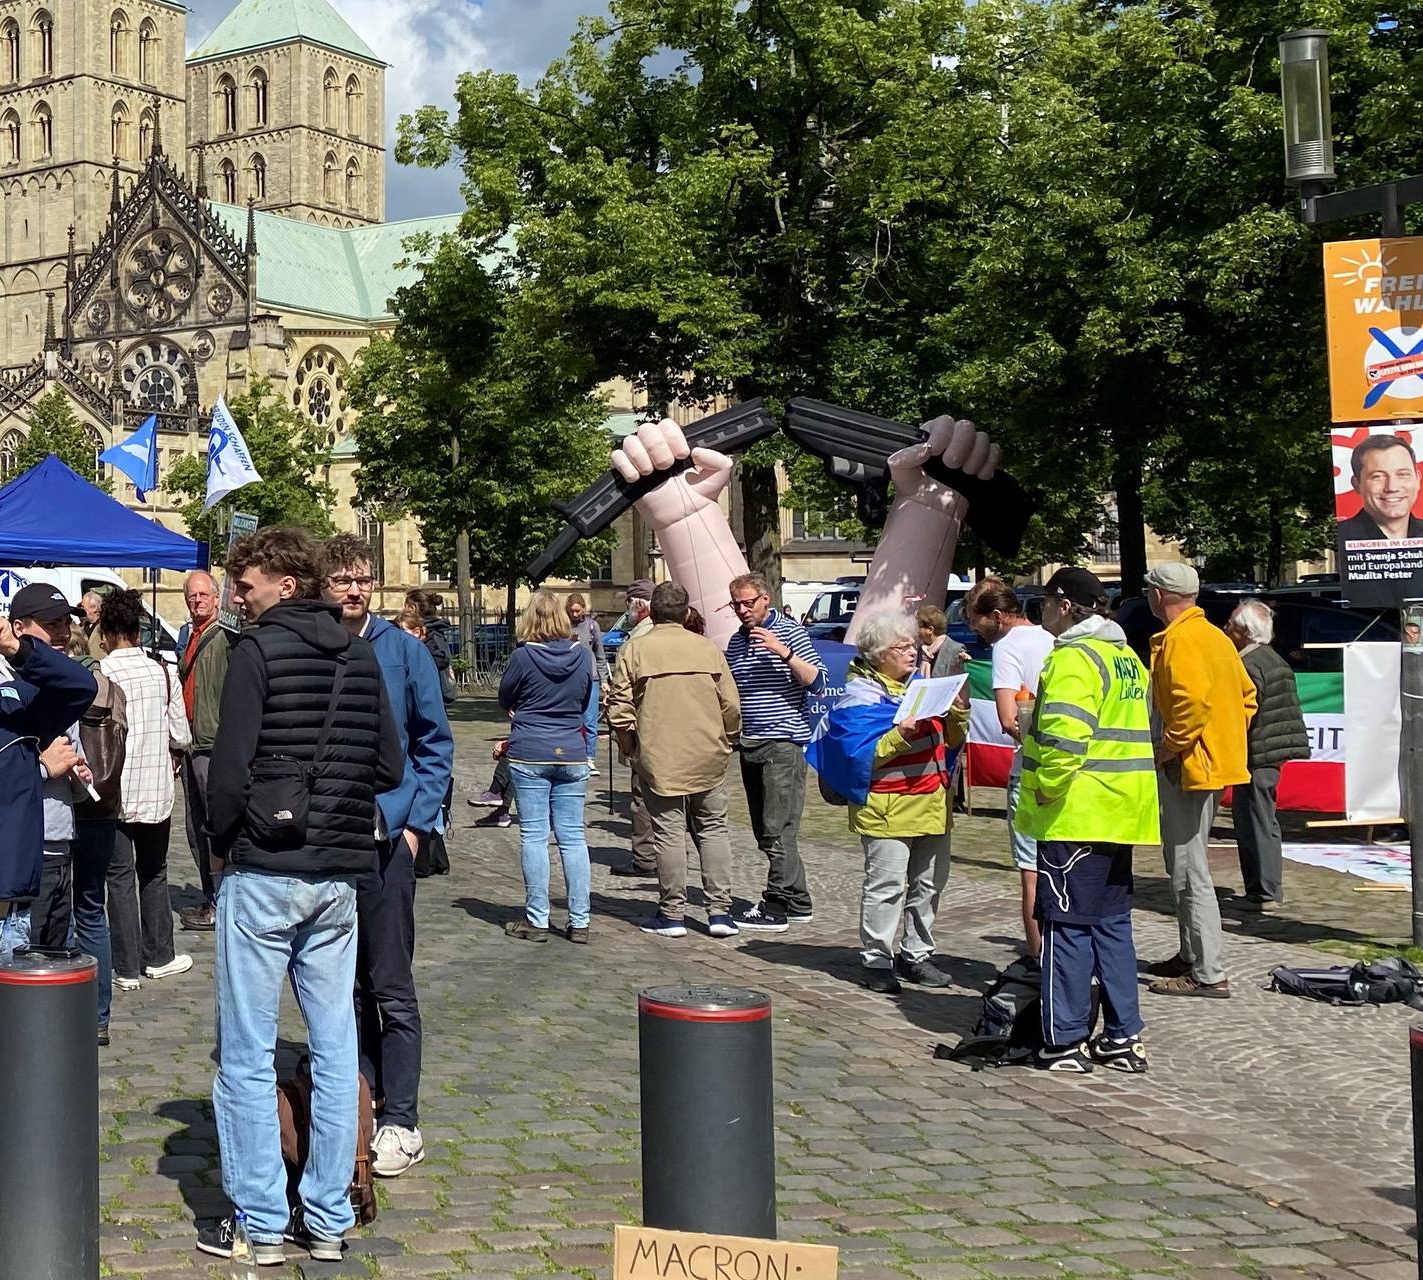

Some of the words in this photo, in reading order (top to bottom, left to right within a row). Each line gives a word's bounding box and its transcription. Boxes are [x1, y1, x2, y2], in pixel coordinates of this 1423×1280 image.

[1364, 275, 1423, 294] FREI
[1354, 295, 1423, 314] WÄHL
[1402, 539, 1423, 547] GESP
[1347, 552, 1364, 562] mit
[1365, 552, 1397, 562] Svenja
[1348, 561, 1367, 571] und
[1368, 559, 1423, 571] Europakand
[1348, 570, 1383, 580] Madita
[1383, 570, 1413, 579] Fester
